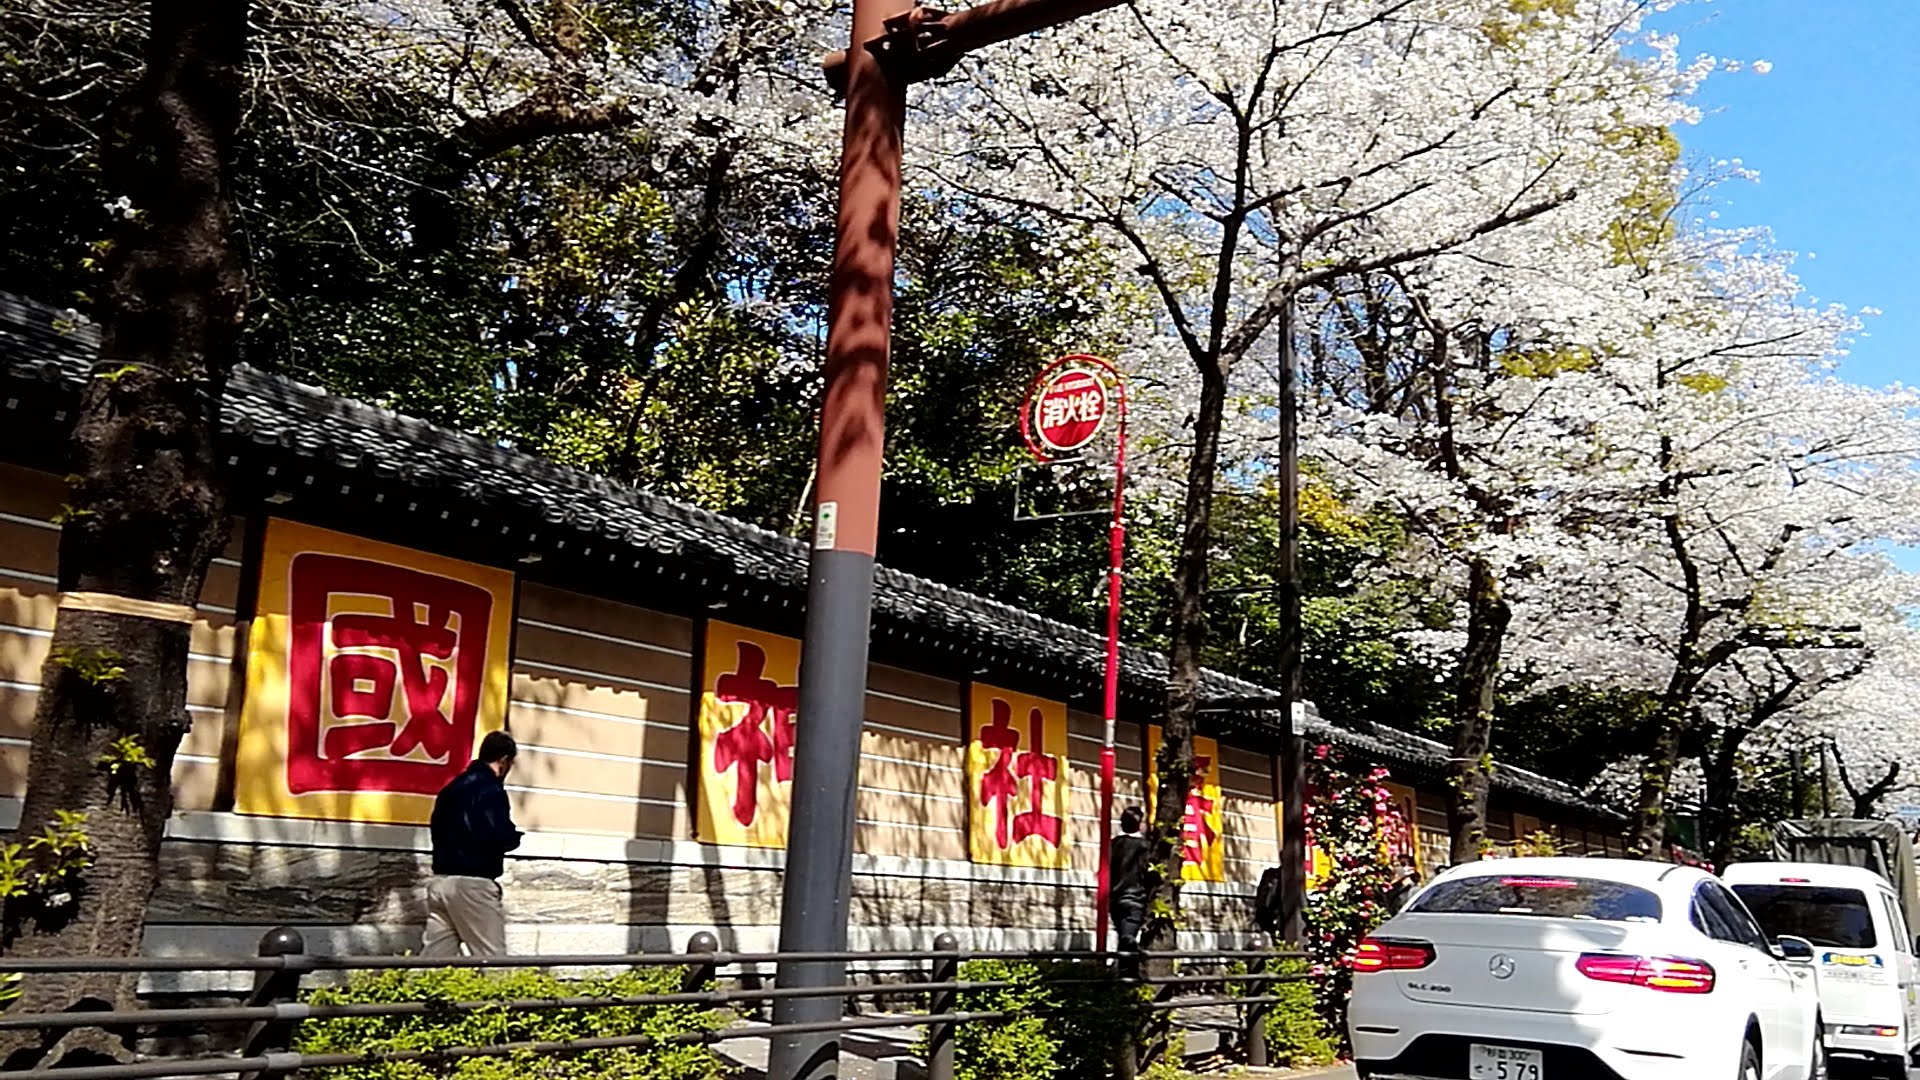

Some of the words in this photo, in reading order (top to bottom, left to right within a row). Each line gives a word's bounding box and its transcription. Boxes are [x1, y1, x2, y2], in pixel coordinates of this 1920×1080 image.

[1042, 389, 1101, 428] 消火栓
[287, 551, 494, 797] 國
[980, 698, 1063, 850] 社
